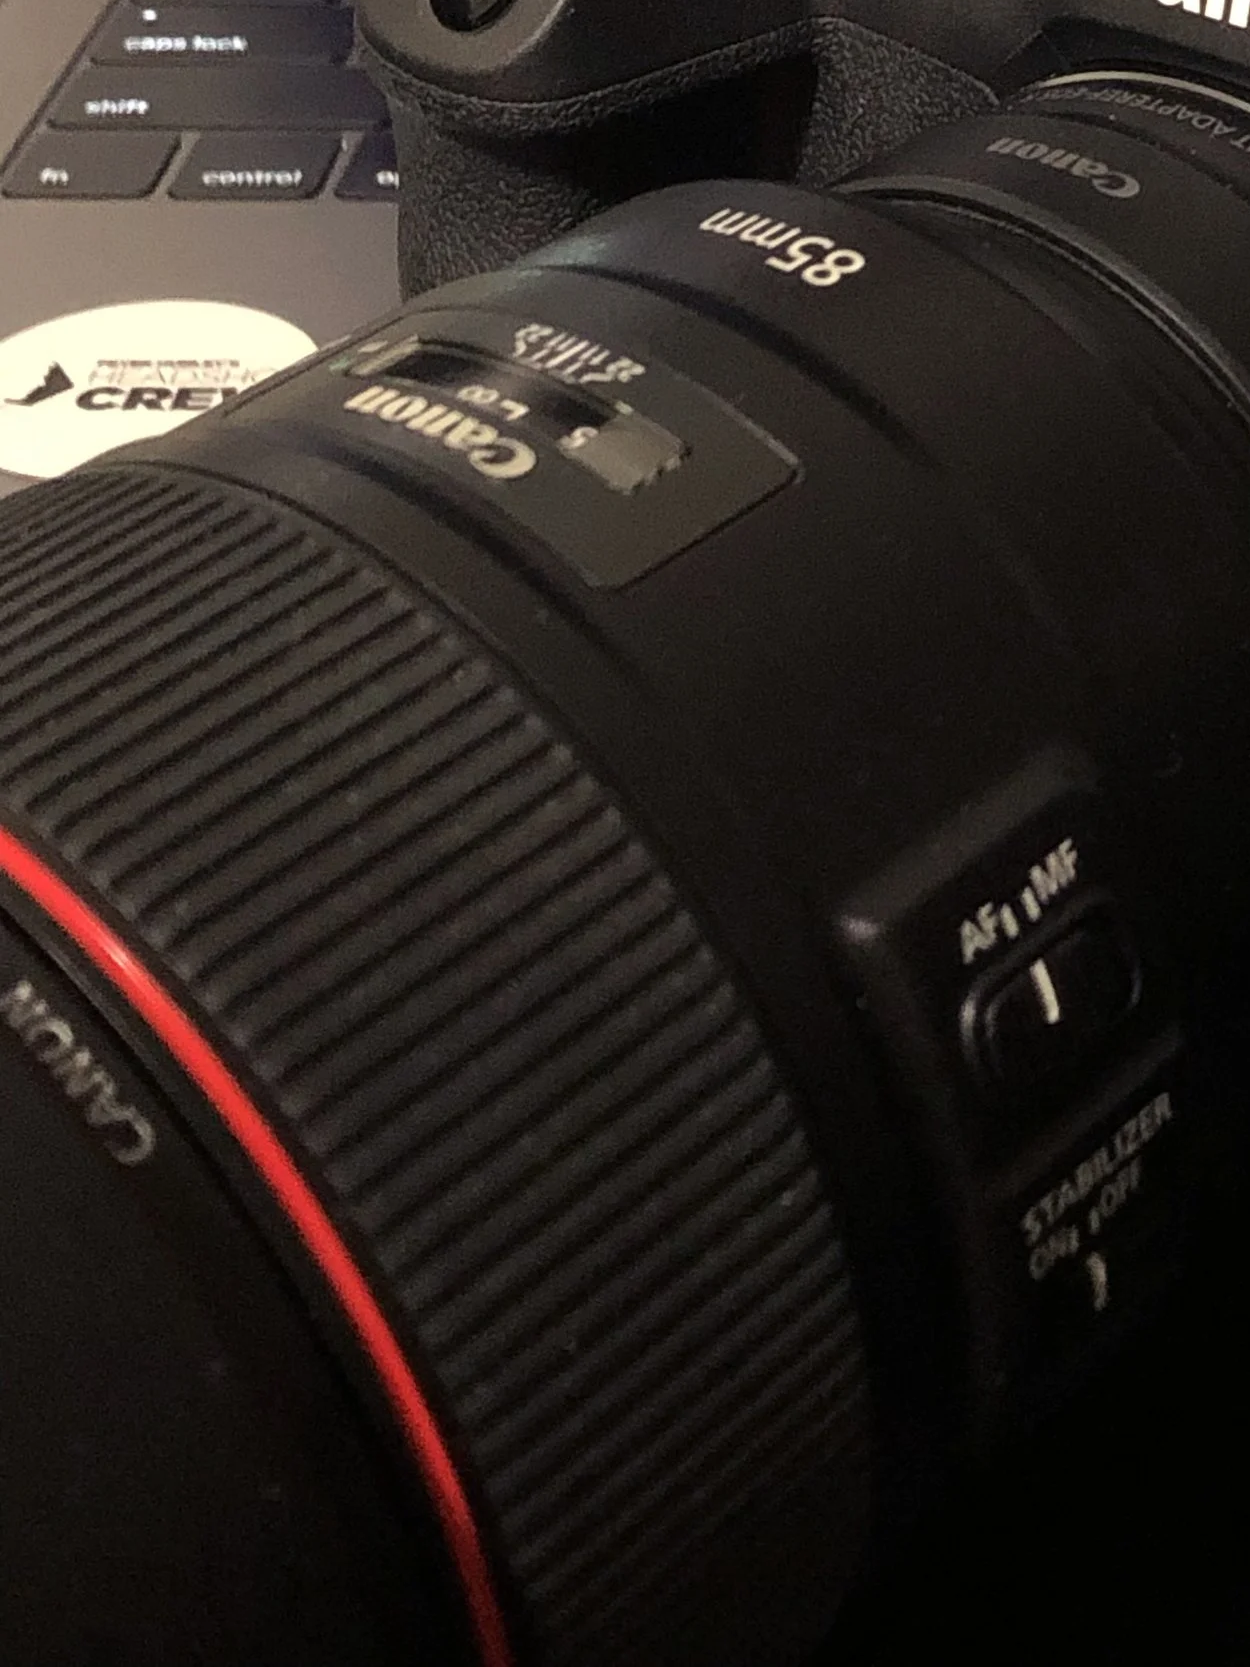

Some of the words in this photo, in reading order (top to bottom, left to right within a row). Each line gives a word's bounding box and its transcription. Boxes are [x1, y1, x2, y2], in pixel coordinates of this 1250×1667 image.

[124, 35, 188, 53] caps
[193, 34, 248, 52] lock
[84, 97, 150, 115] shift
[1115, 90, 1239, 139] ADAPTER
[40, 166, 69, 184] fn
[201, 168, 303, 186] control
[985, 137, 1141, 199] Canon
[699, 207, 867, 287] 85mm
[343, 384, 537, 479] Canon
[960, 901, 1000, 965] AF
[1030, 837, 1079, 904] MF
[1021, 1091, 1173, 1245] STABILIZER
